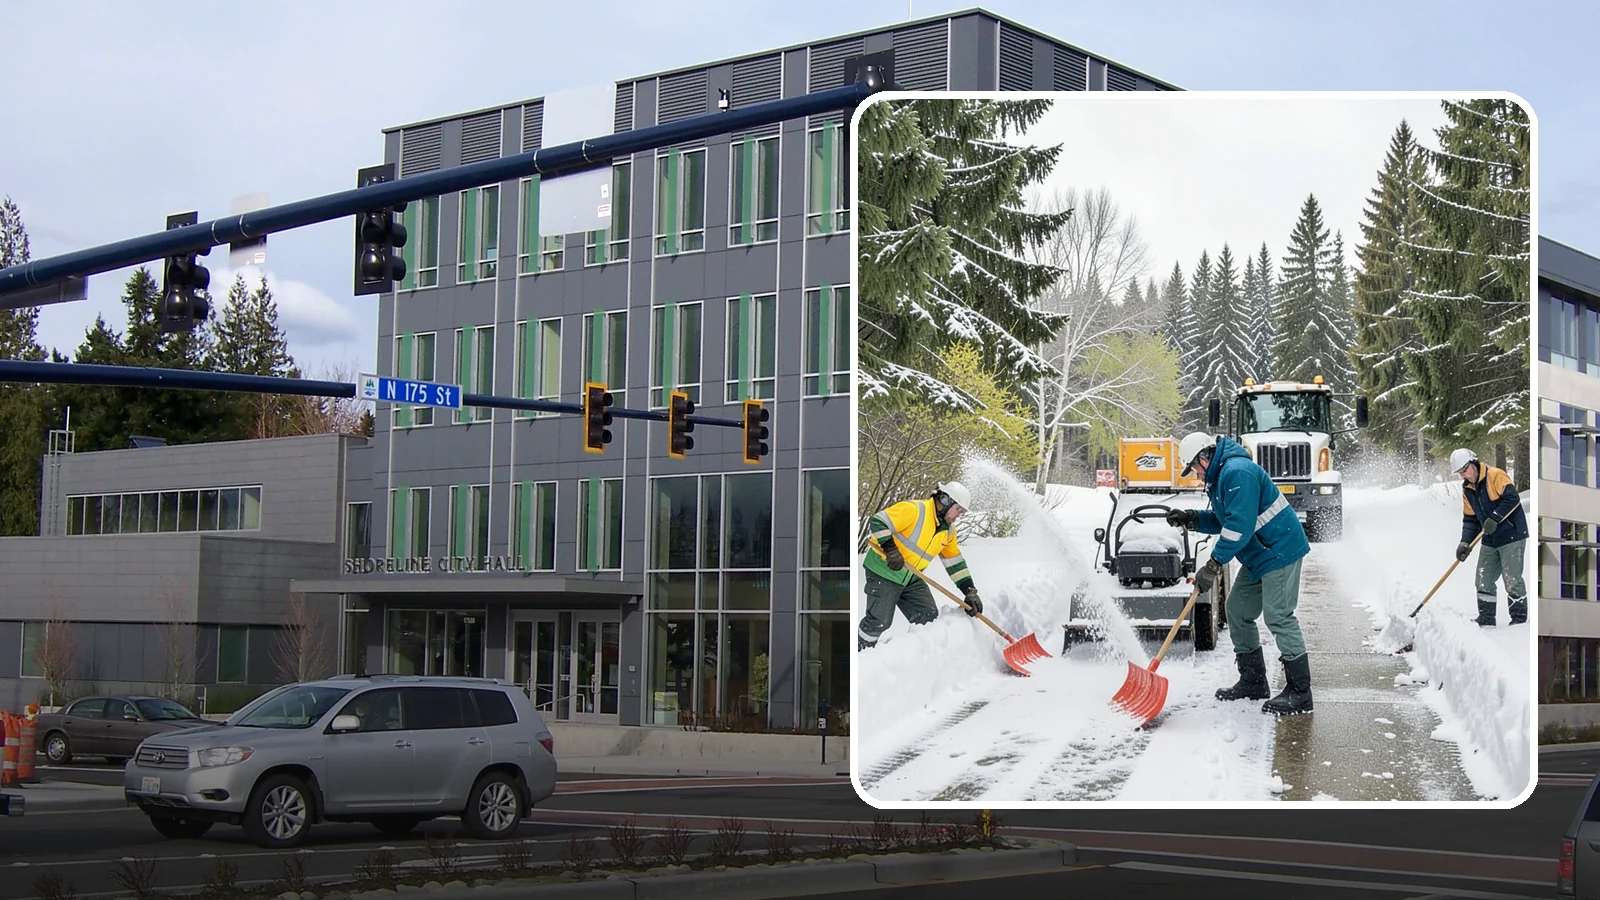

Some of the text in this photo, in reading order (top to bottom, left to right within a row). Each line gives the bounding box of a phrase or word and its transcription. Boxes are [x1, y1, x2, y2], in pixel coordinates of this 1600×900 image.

[387, 380, 451, 406] N 175 St
[343, 555, 526, 574] SHORELINE CITY HALL
